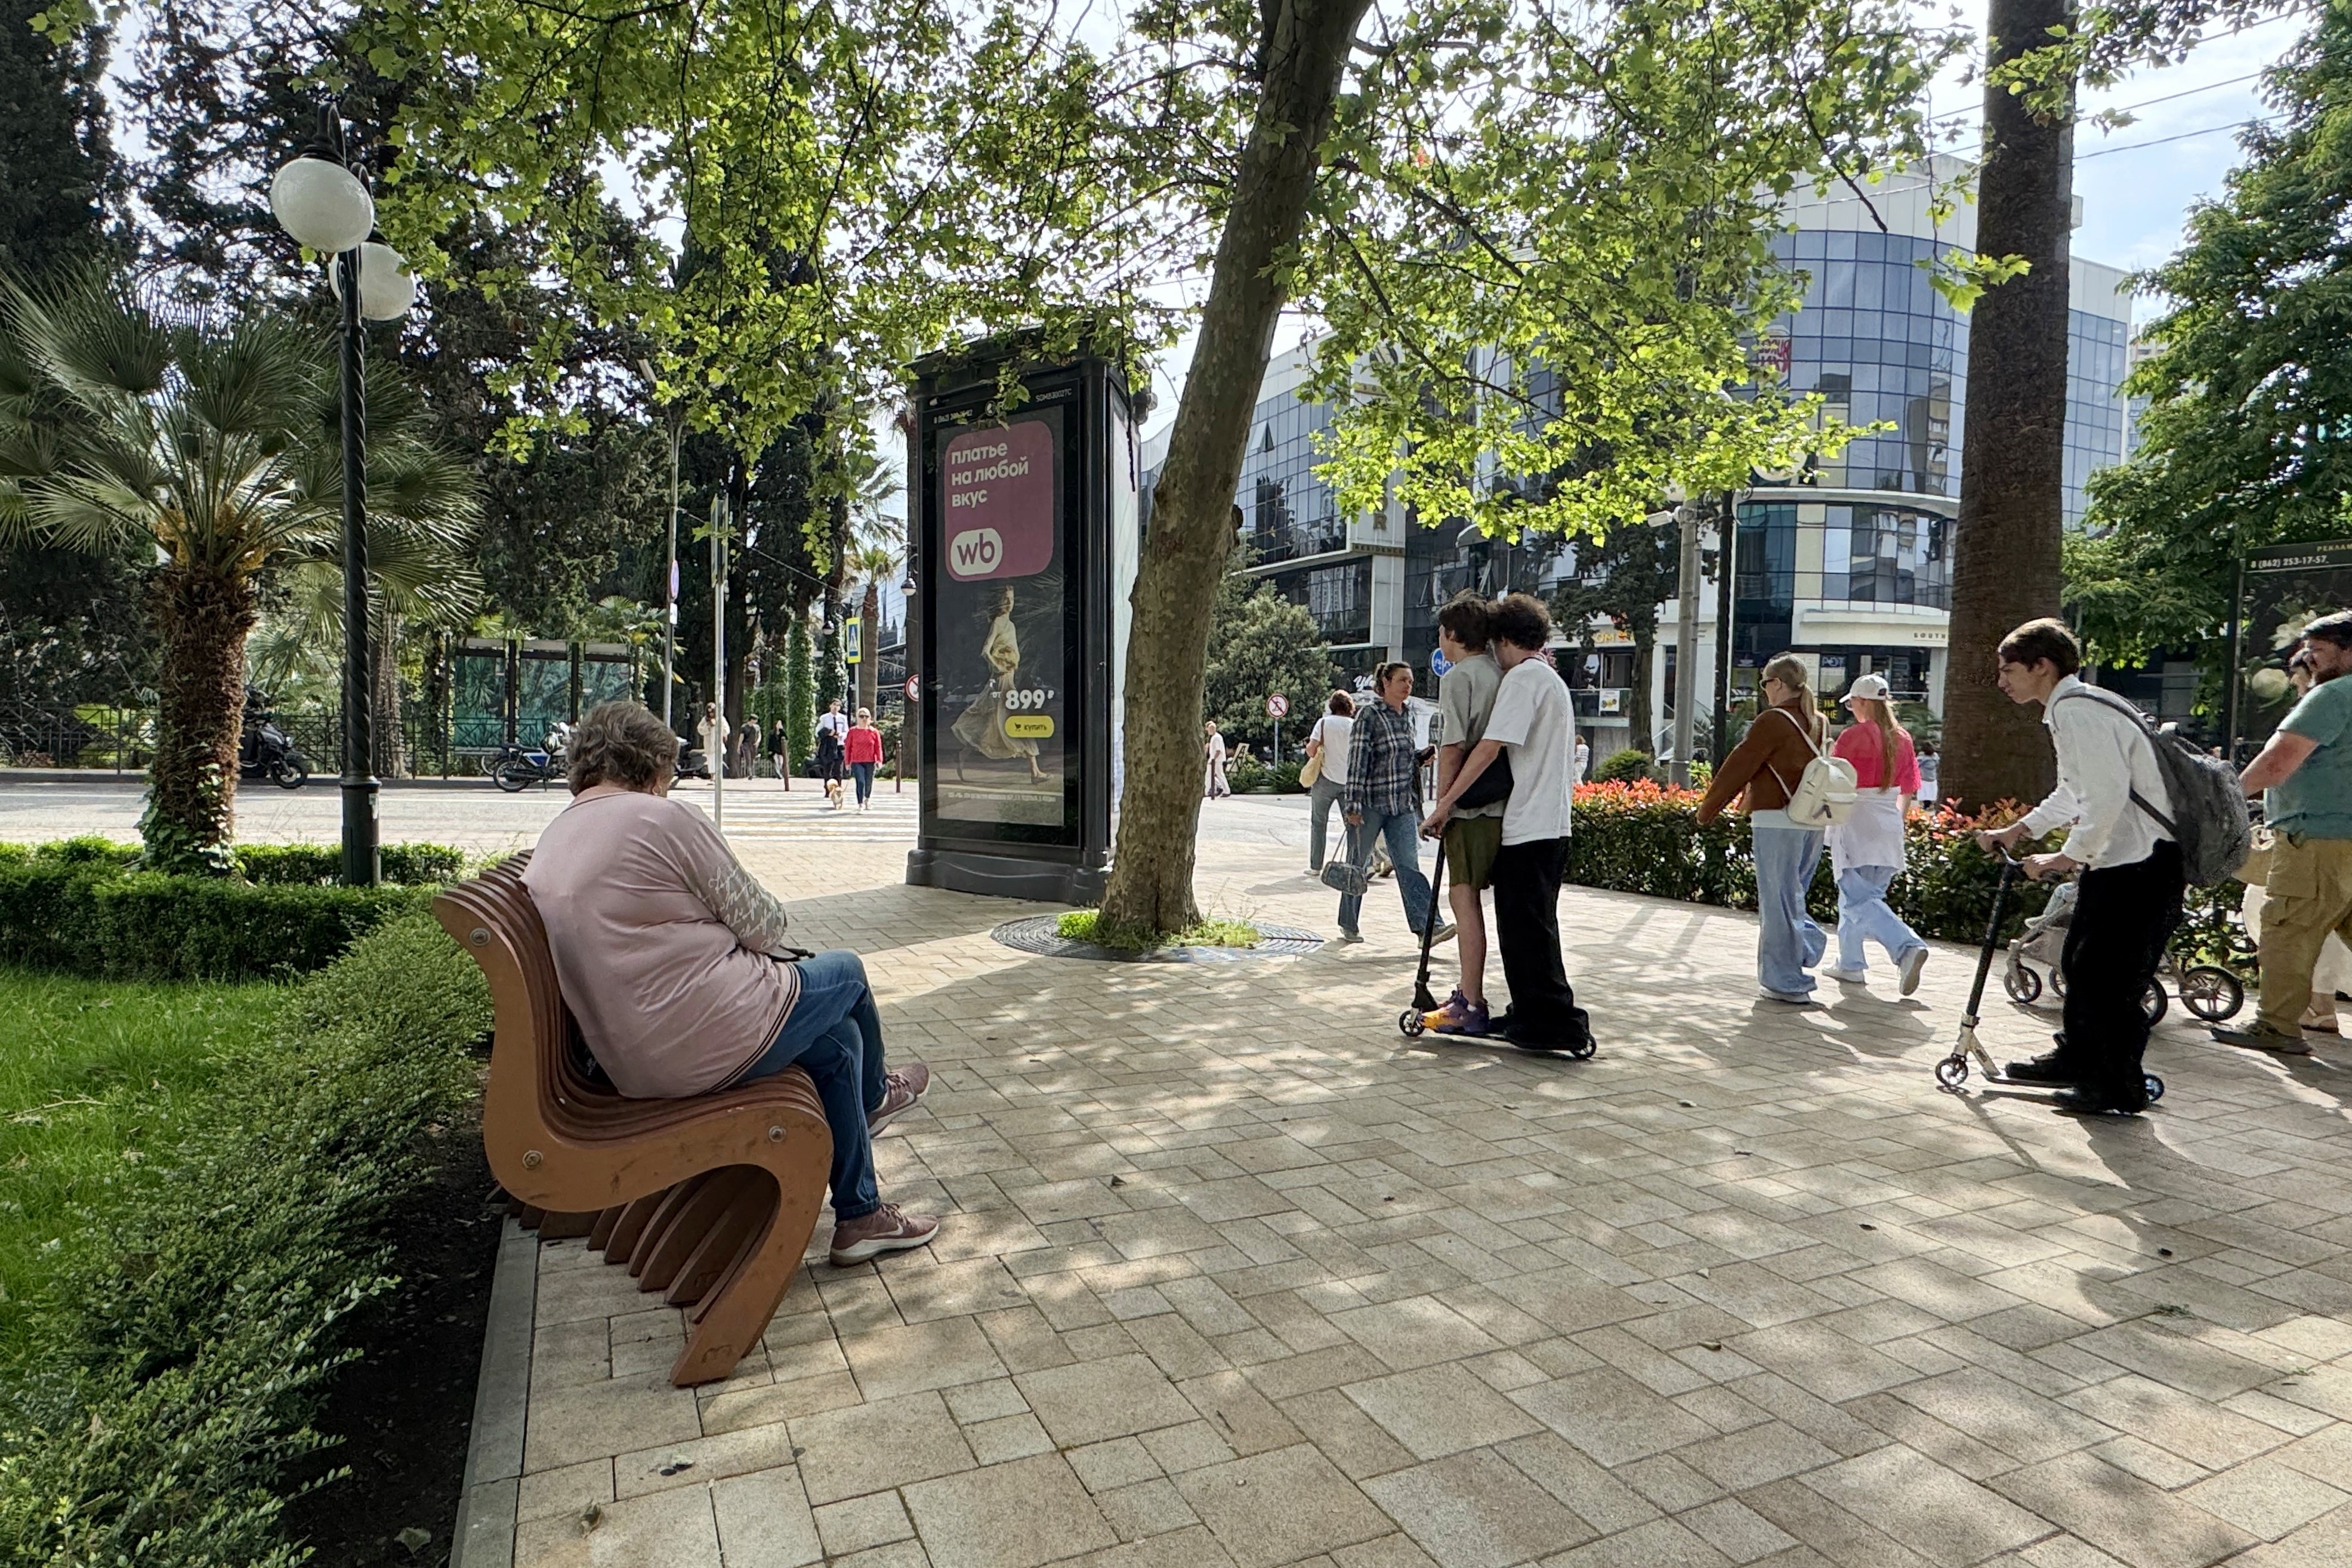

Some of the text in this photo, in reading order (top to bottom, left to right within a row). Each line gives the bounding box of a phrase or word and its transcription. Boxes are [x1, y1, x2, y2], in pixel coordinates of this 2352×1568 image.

[952, 443, 1008, 465] платье
[952, 456, 1029, 486] на любой
[952, 490, 987, 508] вкус
[957, 533, 995, 566] wb
[2258, 558, 2280, 569] (862)
[2283, 555, 2327, 566] 253-17-57
